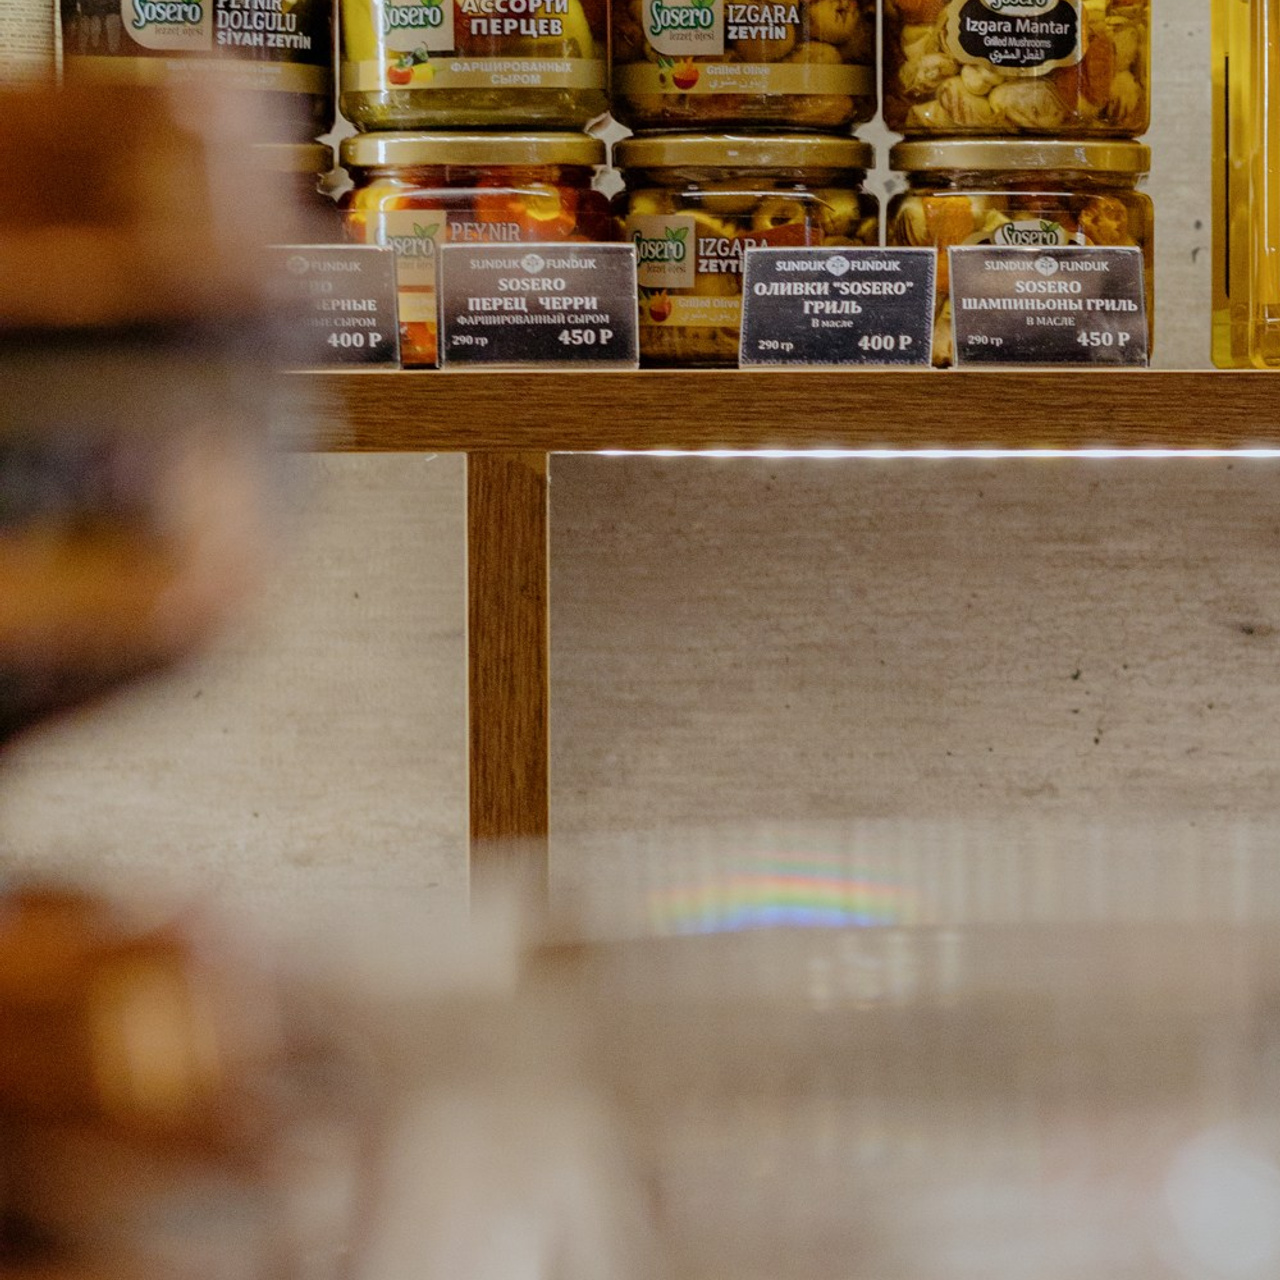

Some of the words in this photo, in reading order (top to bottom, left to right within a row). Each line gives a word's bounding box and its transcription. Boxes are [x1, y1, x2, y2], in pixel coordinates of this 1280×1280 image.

[217, 11, 297, 32] DOLGULU
[727, 5, 800, 24] IZGARA
[470, 18, 563, 38] ПЕРЦЕВ
[966, 17, 1012, 36] Izgara
[1016, 18, 1070, 35] Mantar
[491, 74, 542, 85] СЫРОМ
[470, 258, 521, 270] SUNDUK
[546, 258, 597, 269] FUNDUK
[699, 257, 744, 273] ZEYTİ
[775, 260, 826, 271] SUNDUK
[850, 260, 901, 271] FUNDUK
[984, 260, 1035, 271] SUNDUK
[1059, 261, 1110, 271] FUNDUK
[498, 277, 566, 292] SOSERO
[754, 282, 829, 296] ОЛИВКИ
[1015, 281, 1082, 294] SOSERO
[468, 297, 528, 312] ПЕРЕЦ
[538, 296, 598, 310] ЧЕРРИ
[803, 300, 863, 315] ГРИЛЬ
[961, 298, 1083, 311] ШАМПИНЬОНЫ
[1086, 299, 1138, 311] ГРИЛЬ
[567, 314, 610, 324] СЫРОМ
[821, 319, 854, 328] масле
[1036, 317, 1076, 327] МАСЛЕ
[328, 332, 365, 348] 400
[452, 335, 473, 346] 290
[475, 336, 489, 347] гр
[558, 329, 596, 345] 450
[857, 335, 895, 351] 400
[967, 335, 988, 345] 290
[990, 336, 1003, 347] гр
[1076, 332, 1114, 347] 450
[758, 340, 779, 350] 290
[780, 341, 794, 351] гр
